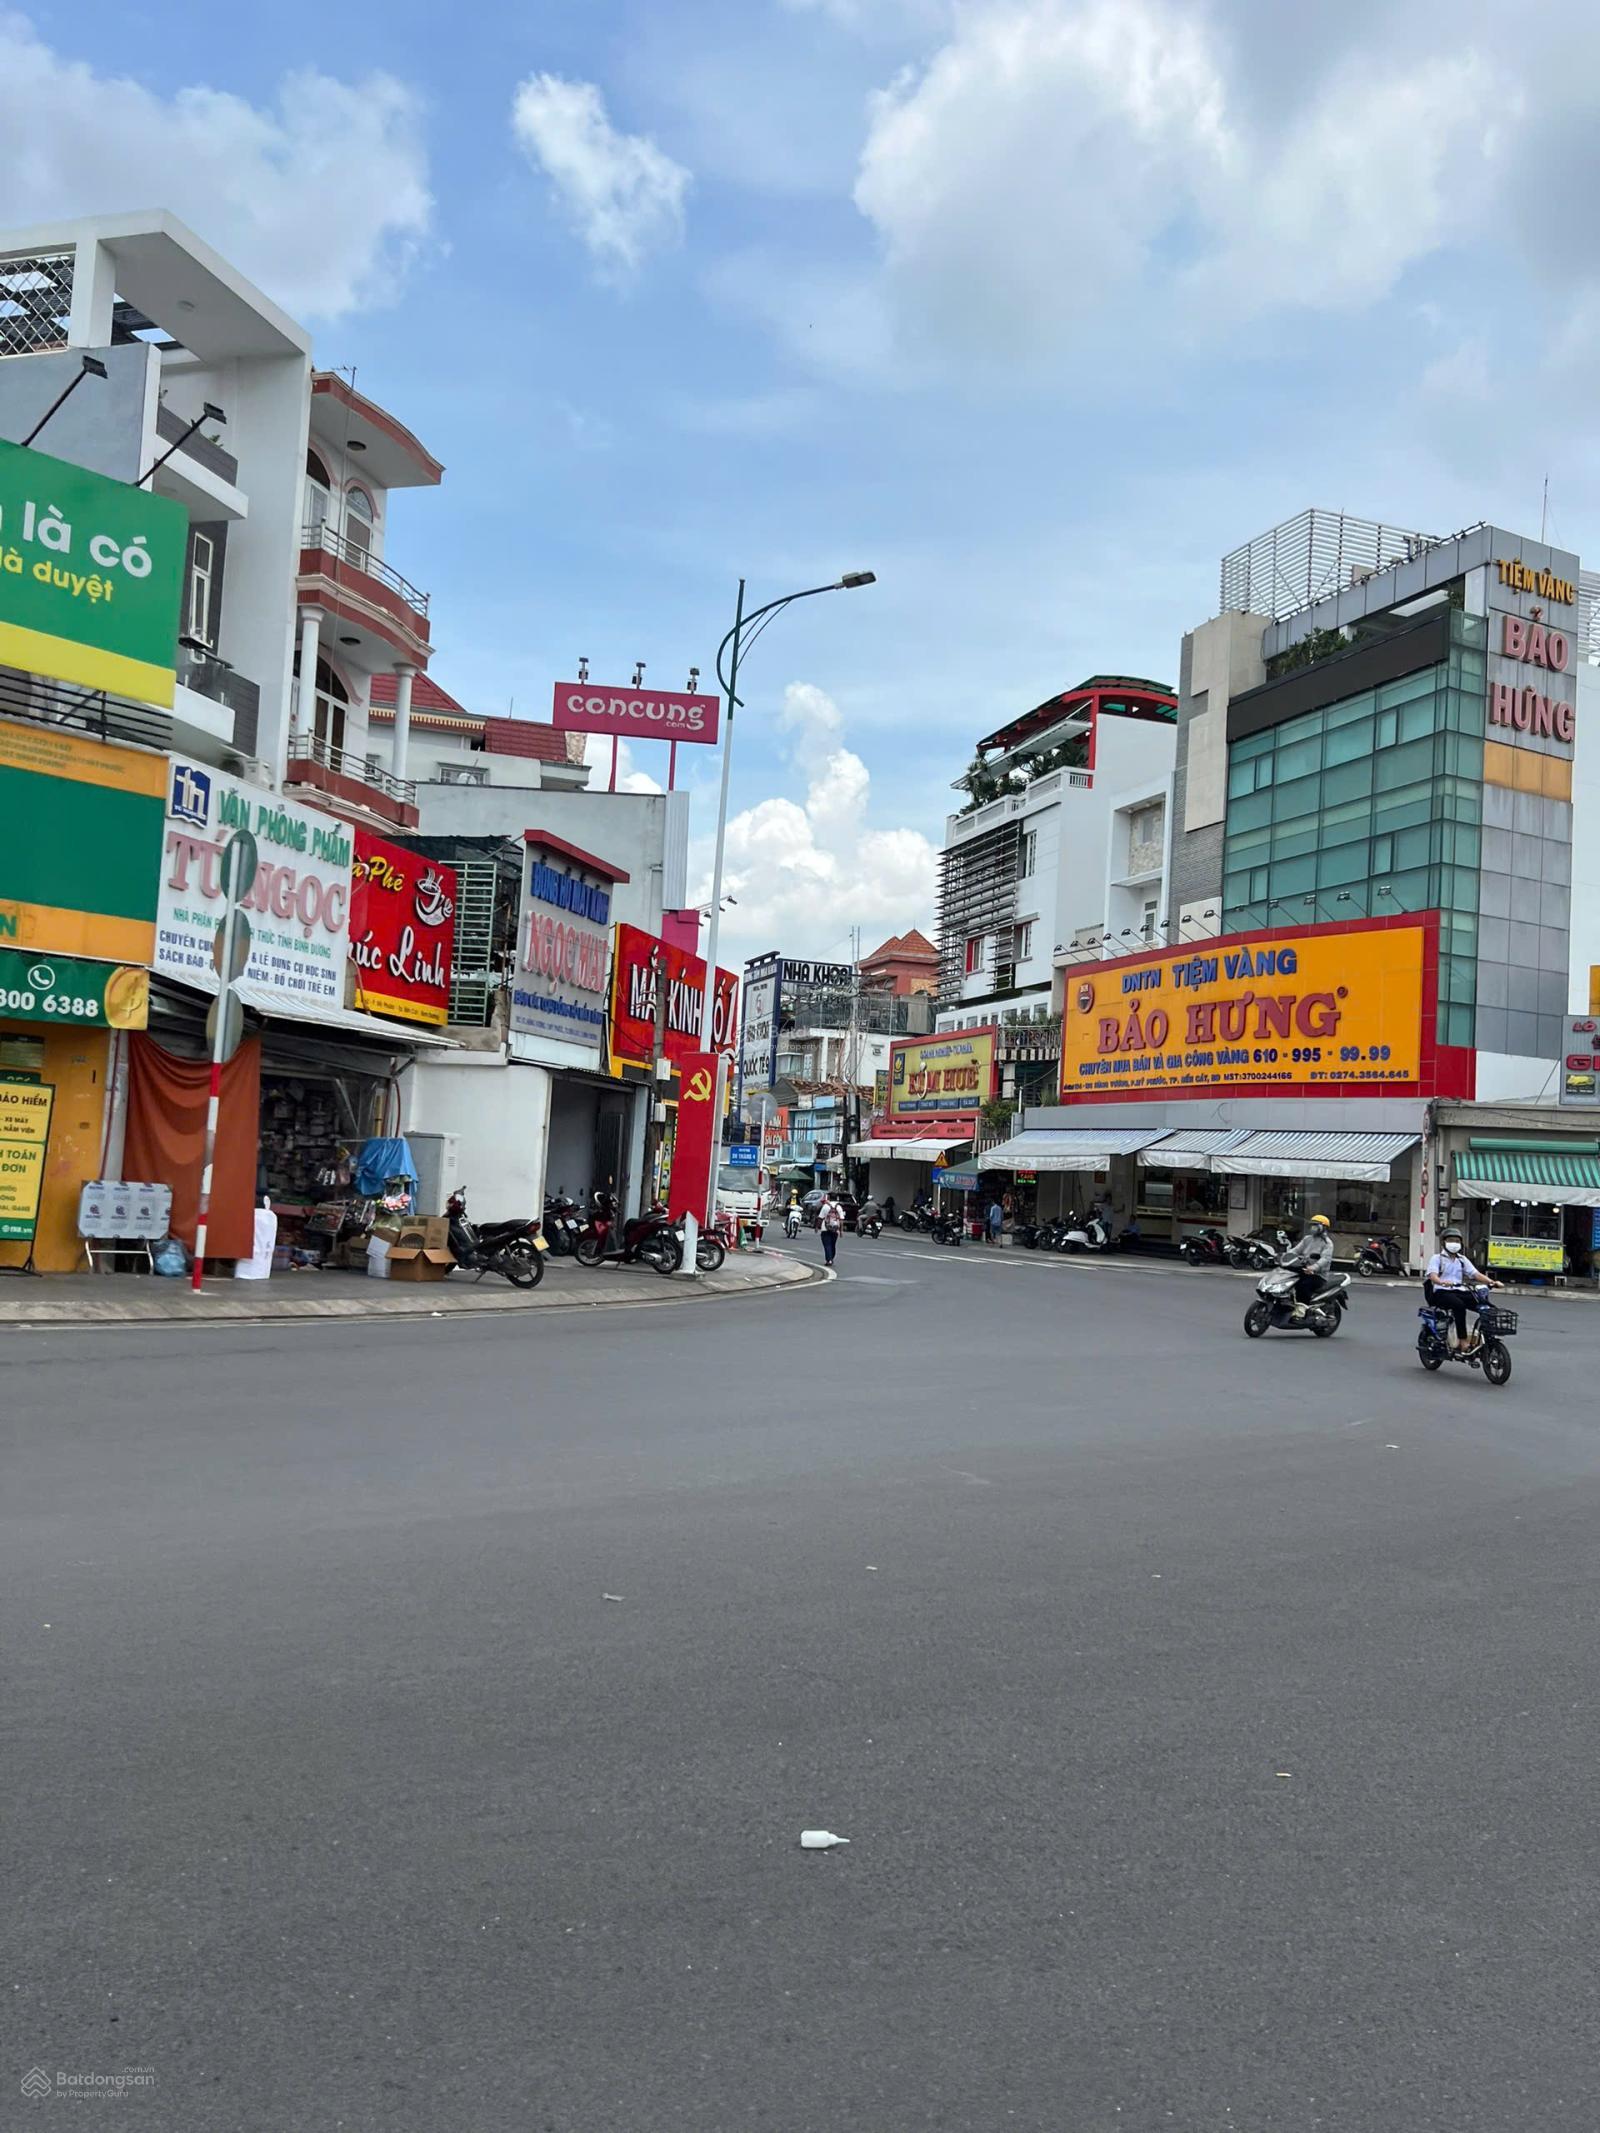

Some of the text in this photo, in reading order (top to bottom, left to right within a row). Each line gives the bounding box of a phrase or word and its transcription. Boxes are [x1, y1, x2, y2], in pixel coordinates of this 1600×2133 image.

[23, 501, 152, 578] là có
[33, 561, 114, 603] duyệt
[1496, 558, 1575, 605] TIỆM VÀNG
[1503, 605, 1569, 673] BẢO
[1490, 681, 1575, 744] HƯNG
[217, 788, 351, 868] VĂN PHÒNG PHẨM
[240, 861, 347, 938] NGỌC
[369, 856, 405, 892] Phê
[389, 926, 446, 988] Linh
[523, 910, 576, 996] NGỌC
[1122, 947, 1297, 993] DNTN TIỆM VÀNG
[42, 994, 99, 1018] 6388
[630, 945, 659, 1023] MẮ
[668, 968, 704, 1036] KÍNH
[713, 978, 724, 1044] Ố
[1097, 990, 1342, 1054] BẢO HƯNG
[1185, 1050, 1214, 1067] CÔNG
[1216, 1047, 1249, 1065] VÀNG
[1253, 1049, 1278, 1063] 610
[1292, 1048, 1321, 1062] 995
[1340, 1045, 1391, 1062] 99.99
[7, 1148, 37, 1161] TOÁN
